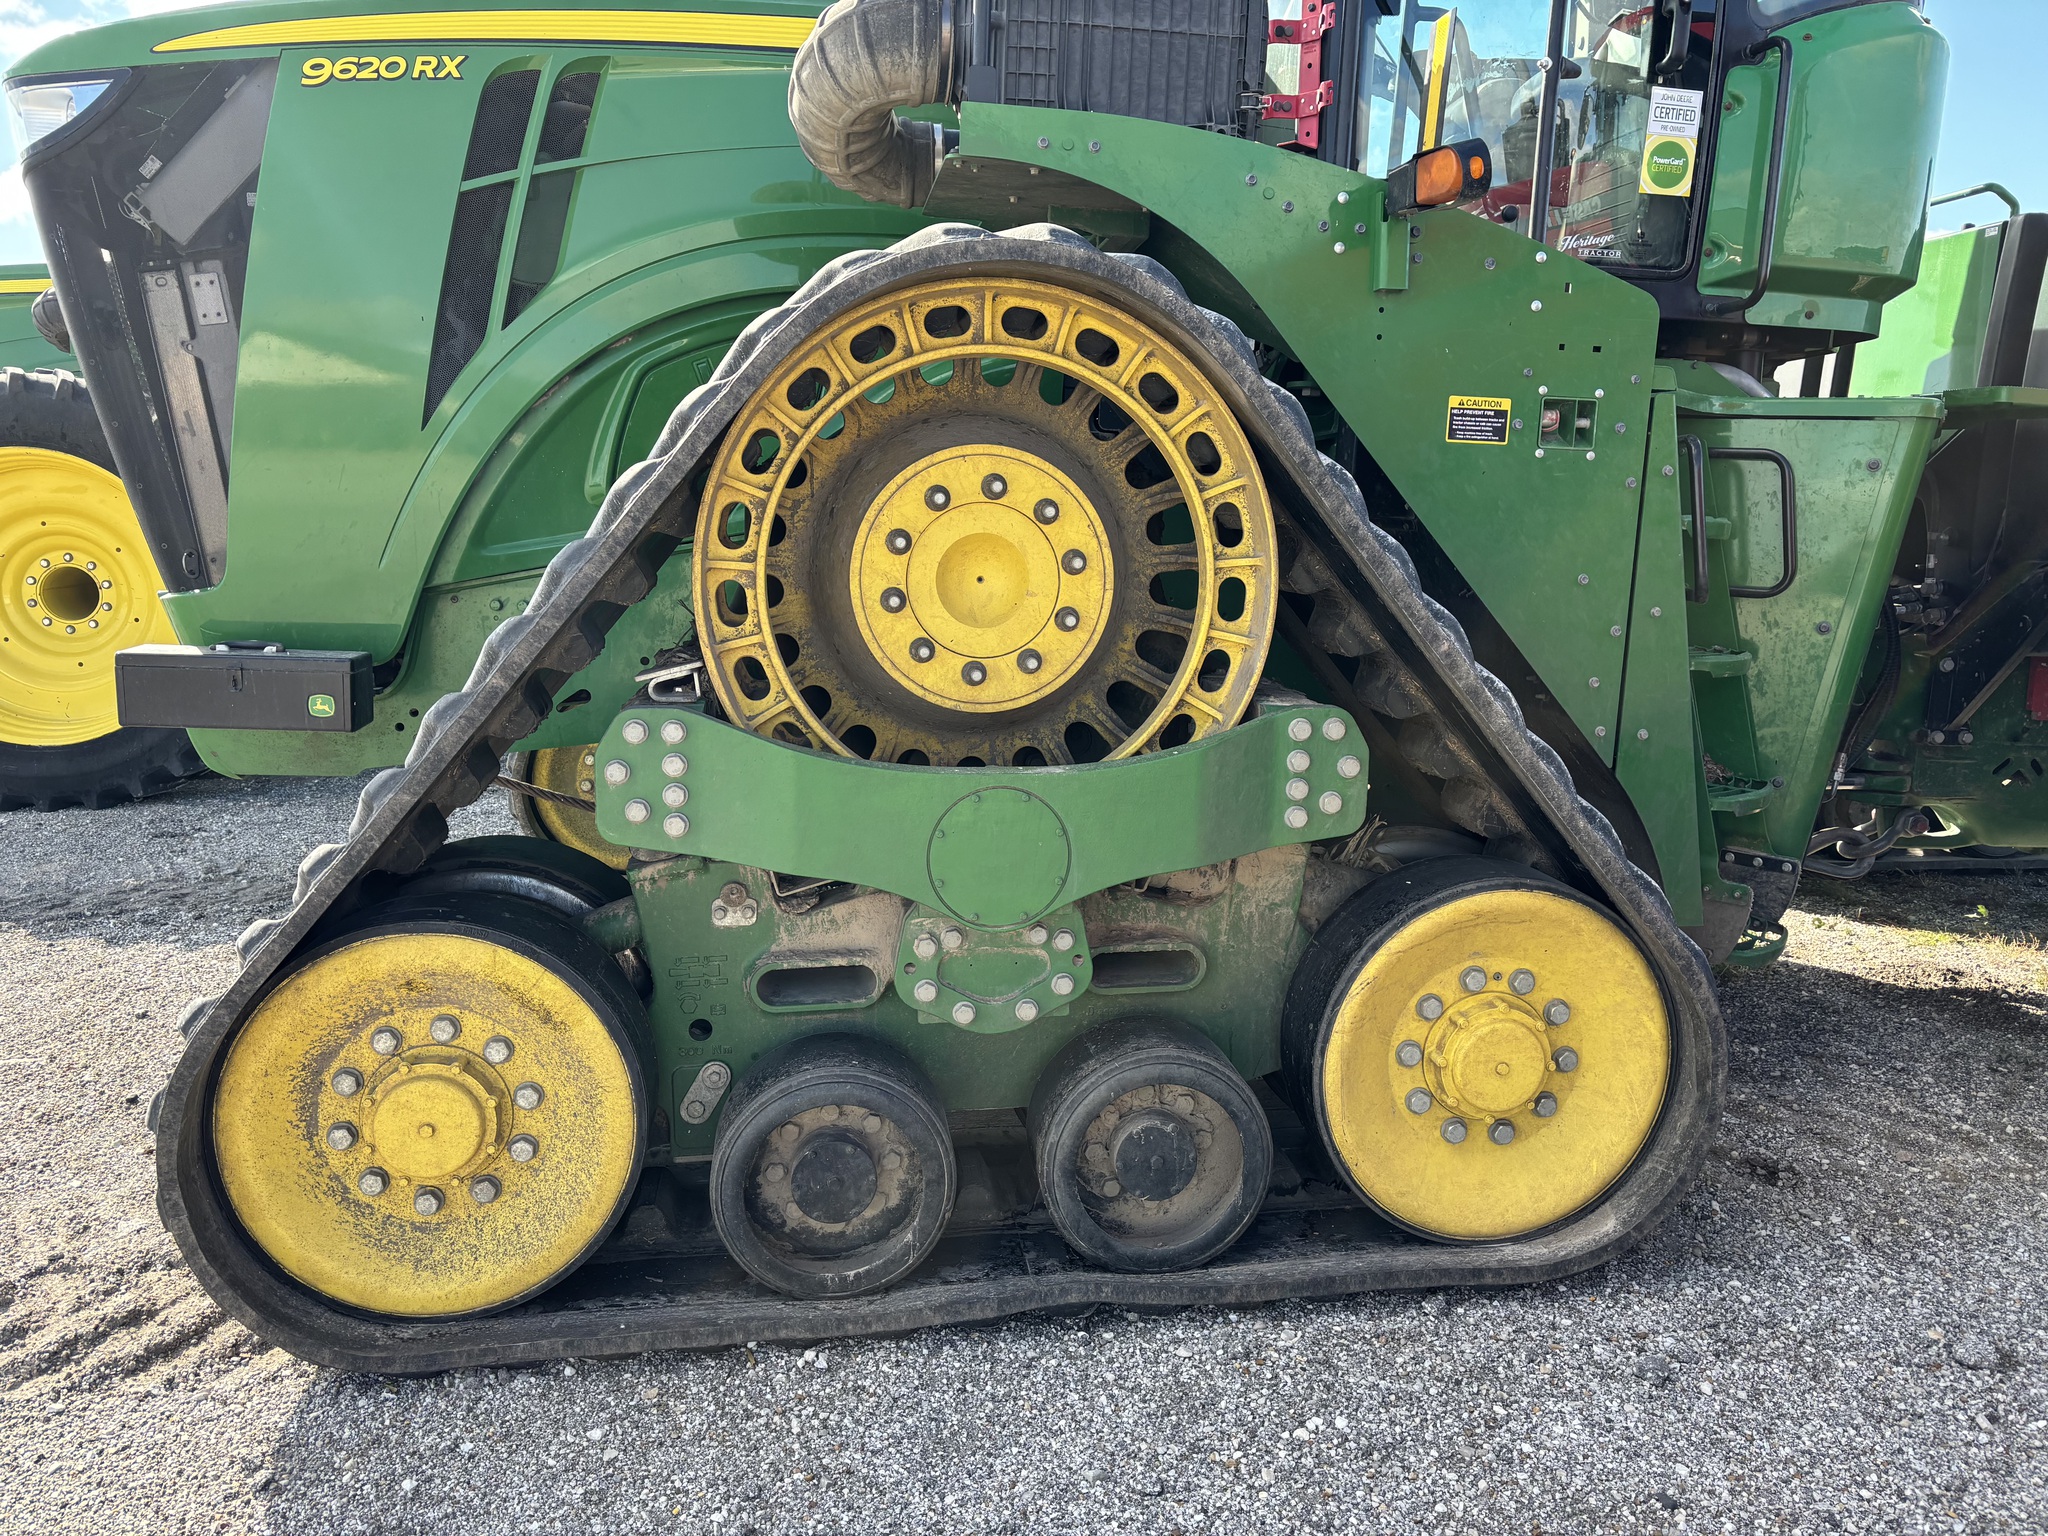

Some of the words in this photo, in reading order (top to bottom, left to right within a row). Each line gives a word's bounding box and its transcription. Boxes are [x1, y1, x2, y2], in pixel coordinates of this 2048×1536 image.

[301, 56, 408, 87] 9620
[411, 55, 468, 80] RX
[1661, 93, 1676, 101] JOHN
[1677, 95, 1693, 103] DEERE
[1654, 106, 1696, 122] CERTIFIED
[1661, 125, 1686, 133] PRE-OWNED
[1652, 164, 1683, 174] CERTIFIED
[1559, 233, 1615, 252] Heritage
[1578, 249, 1621, 258] TRACTOR
[1466, 399, 1502, 408] CAUTION
